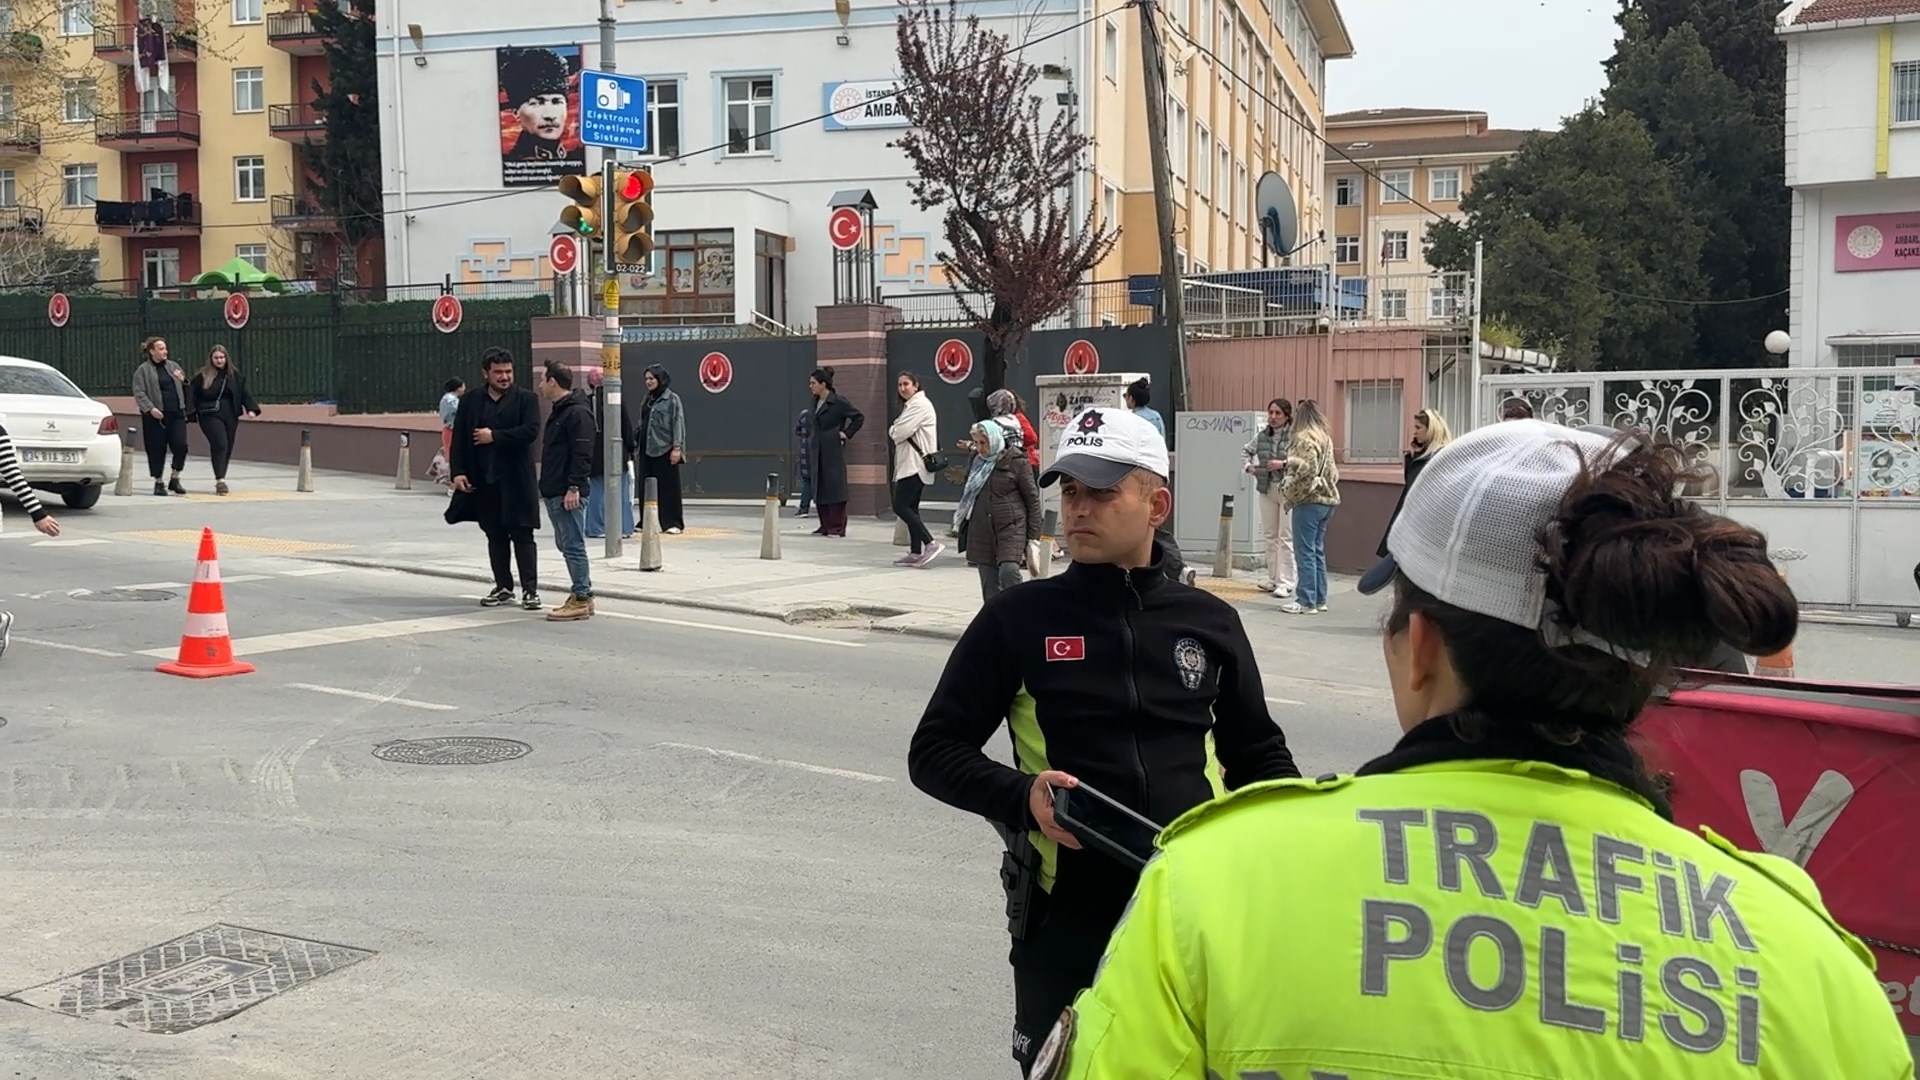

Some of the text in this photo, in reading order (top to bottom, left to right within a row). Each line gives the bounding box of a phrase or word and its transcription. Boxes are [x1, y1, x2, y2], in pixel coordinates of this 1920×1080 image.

[587, 110, 640, 124] Elektronik
[585, 120, 641, 135] Denetleme
[593, 131, 633, 144] Sistemi
[615, 263, 646, 273] 02-022
